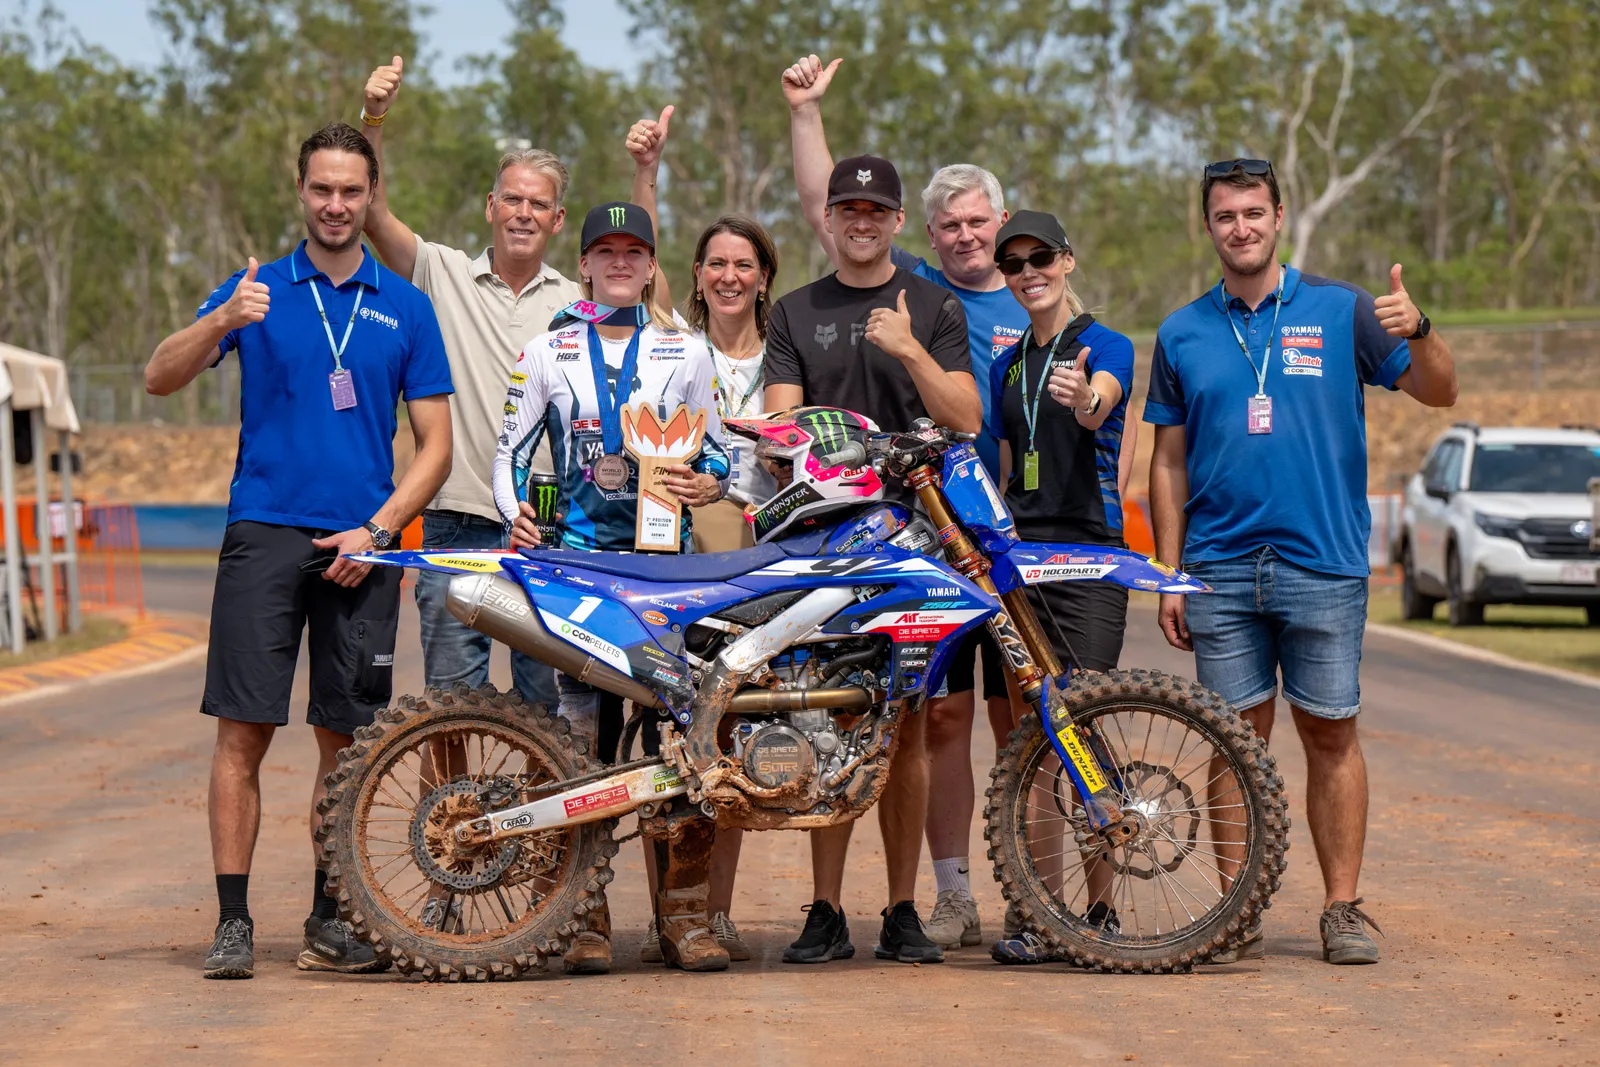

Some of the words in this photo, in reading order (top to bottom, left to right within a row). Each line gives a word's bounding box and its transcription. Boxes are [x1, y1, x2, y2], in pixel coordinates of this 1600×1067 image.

[370, 310, 398, 328] YAMAHA
[1003, 327, 1025, 336] YAMA
[1291, 326, 1322, 334] YAMAHA
[1059, 361, 1076, 370] YAMA
[573, 421, 588, 431] DE
[844, 469, 865, 478] BELL
[974, 463, 1007, 521] 1
[766, 488, 811, 516] MONSTER
[775, 499, 806, 519] ENERGY
[836, 529, 870, 553] GoPro
[447, 559, 488, 568] DUNLOP
[1043, 567, 1102, 577] HOCOPARTS
[927, 587, 962, 597] YAMAHA
[500, 593, 532, 615] HGS
[568, 596, 604, 624] 1
[919, 601, 970, 610] 250F
[572, 629, 621, 659] CORPELLETS
[1067, 741, 1097, 787] DUNLOP
[566, 799, 583, 811] DE
[506, 817, 529, 830] AFAM
